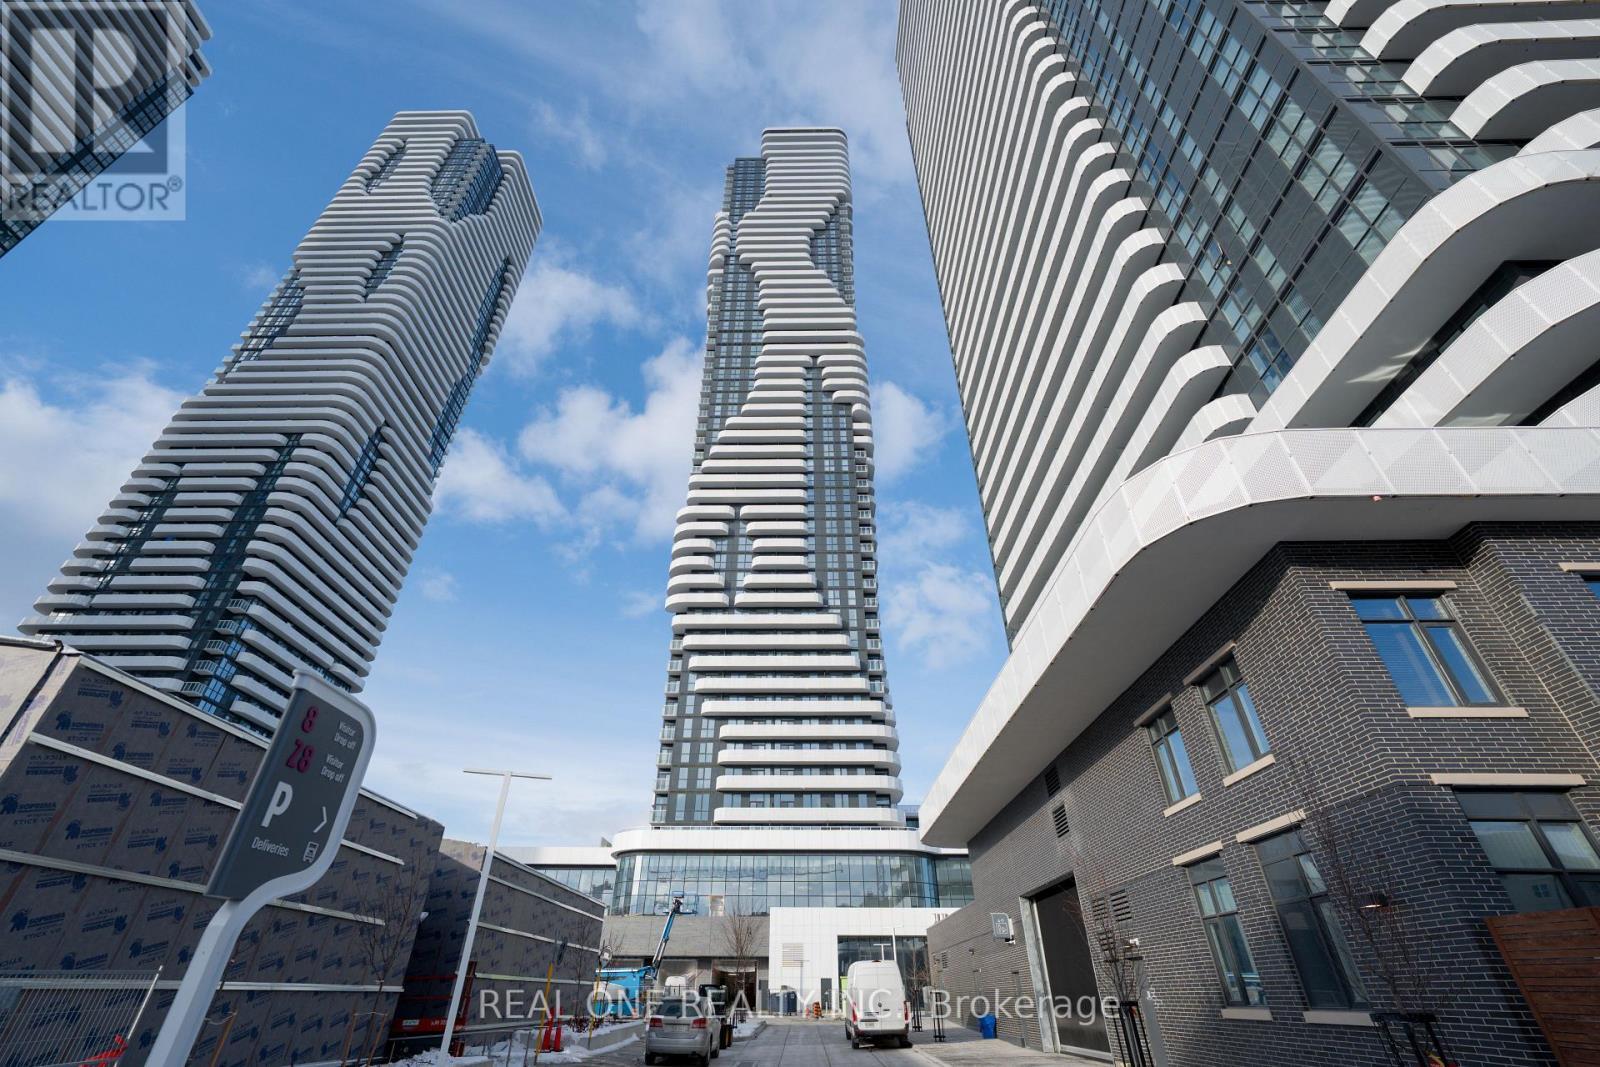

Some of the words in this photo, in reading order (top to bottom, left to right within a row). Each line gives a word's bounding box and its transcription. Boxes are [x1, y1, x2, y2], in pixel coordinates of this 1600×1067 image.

[302, 707, 319, 733] 8
[339, 721, 356, 736] Visitor
[334, 732, 348, 747] Drop
[286, 739, 314, 773] 28
[326, 754, 344, 769] Visitor
[321, 766, 336, 782] Drop
[334, 773, 345, 783] off
[261, 781, 293, 828] P
[251, 836, 290, 857] Deliveries
